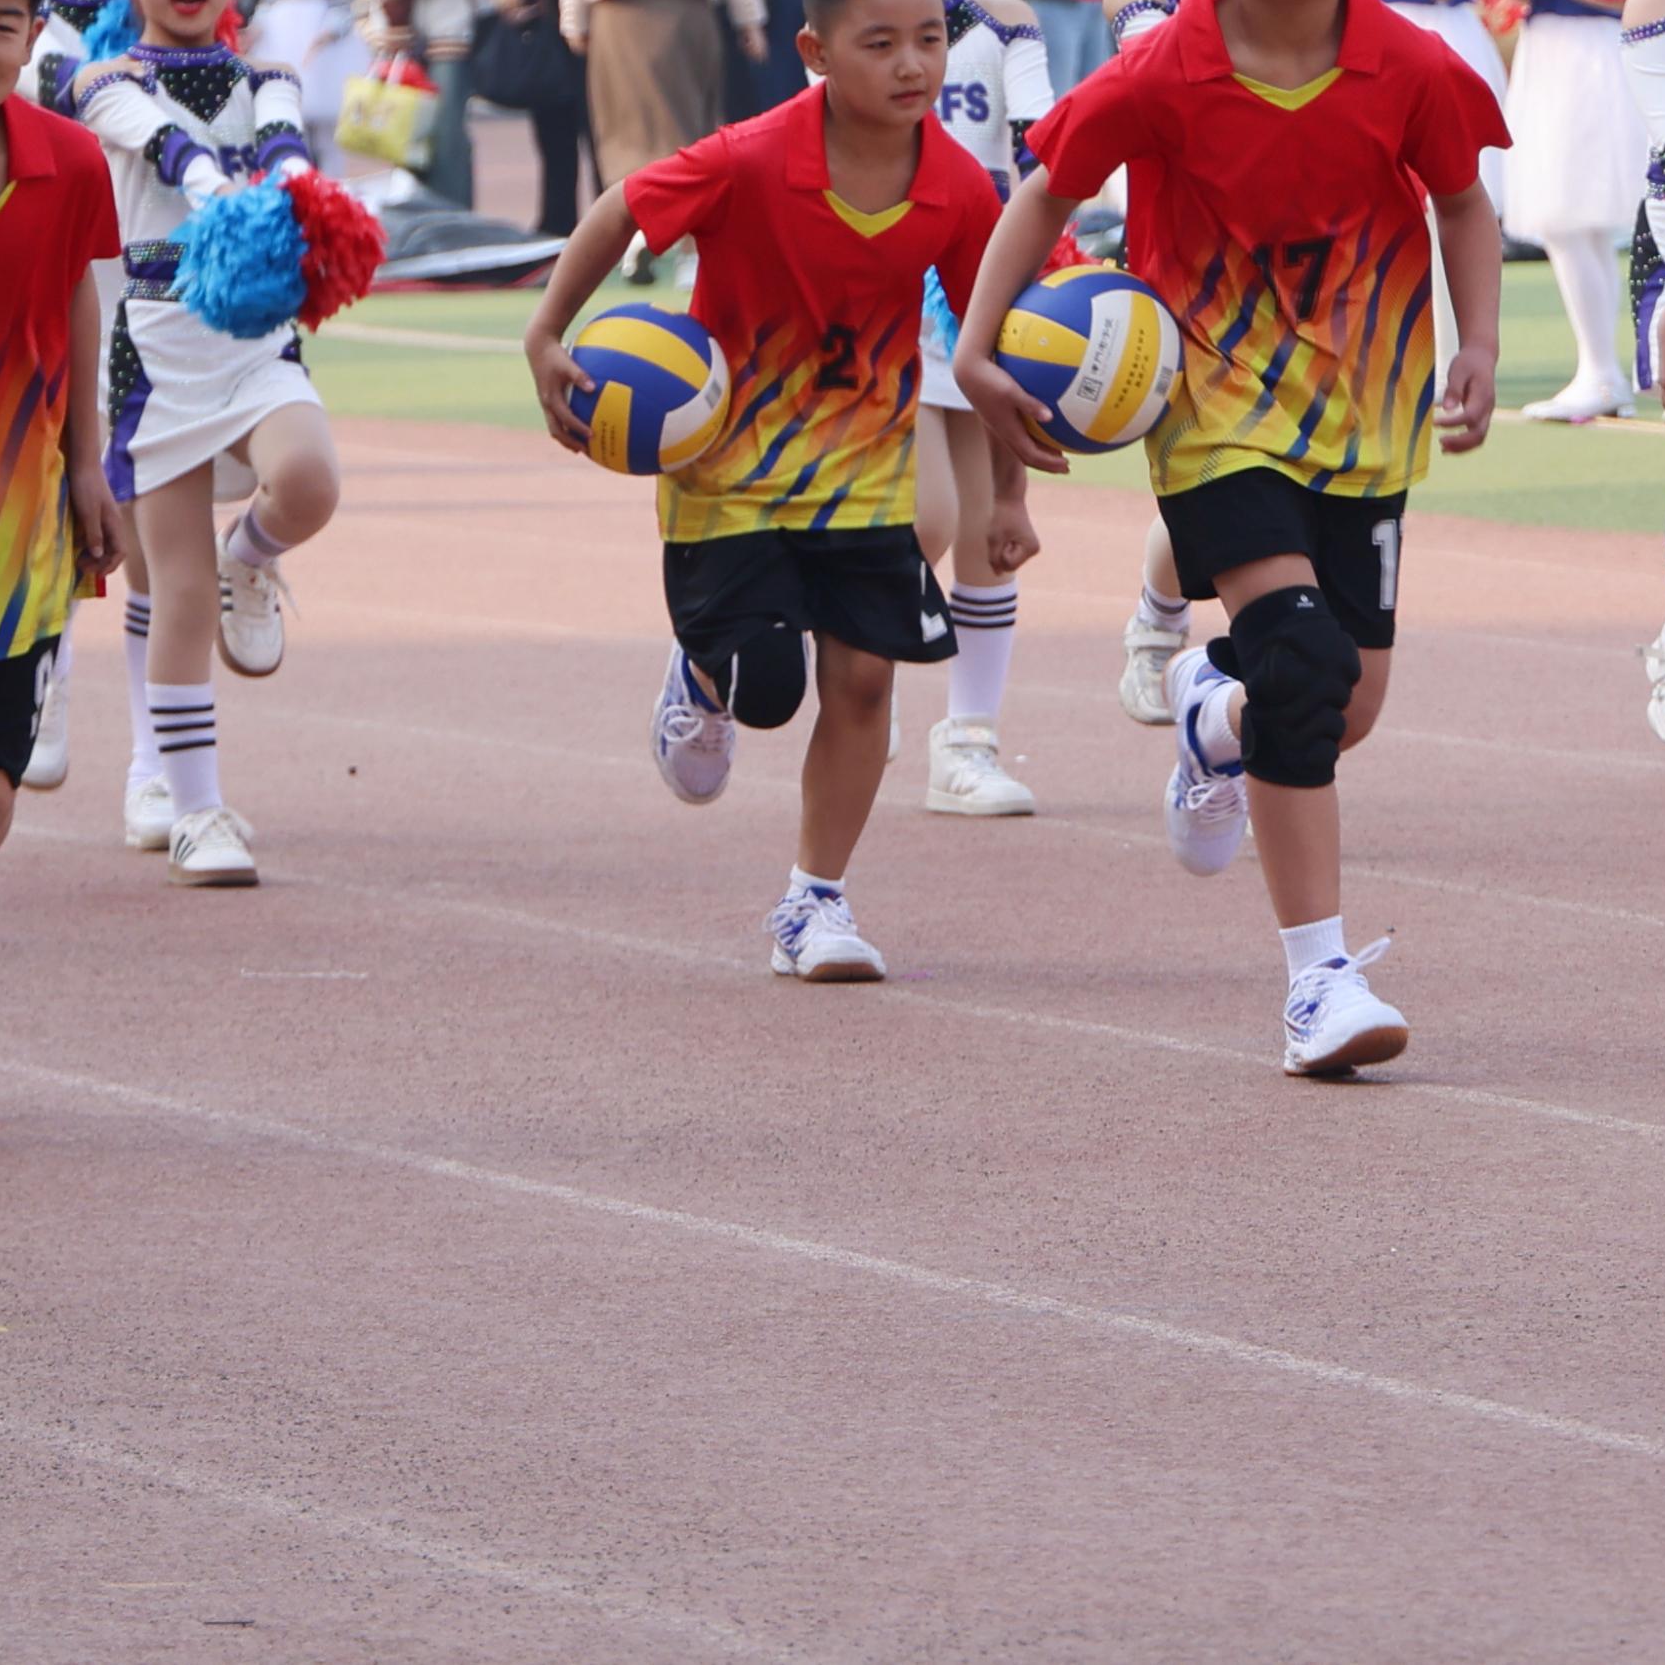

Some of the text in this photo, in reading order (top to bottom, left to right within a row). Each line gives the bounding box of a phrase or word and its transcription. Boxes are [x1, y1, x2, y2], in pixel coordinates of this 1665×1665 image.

[937, 81, 991, 123] FS
[1250, 232, 1337, 324] 17
[814, 323, 859, 391] 2
[1371, 514, 1405, 611] 1
